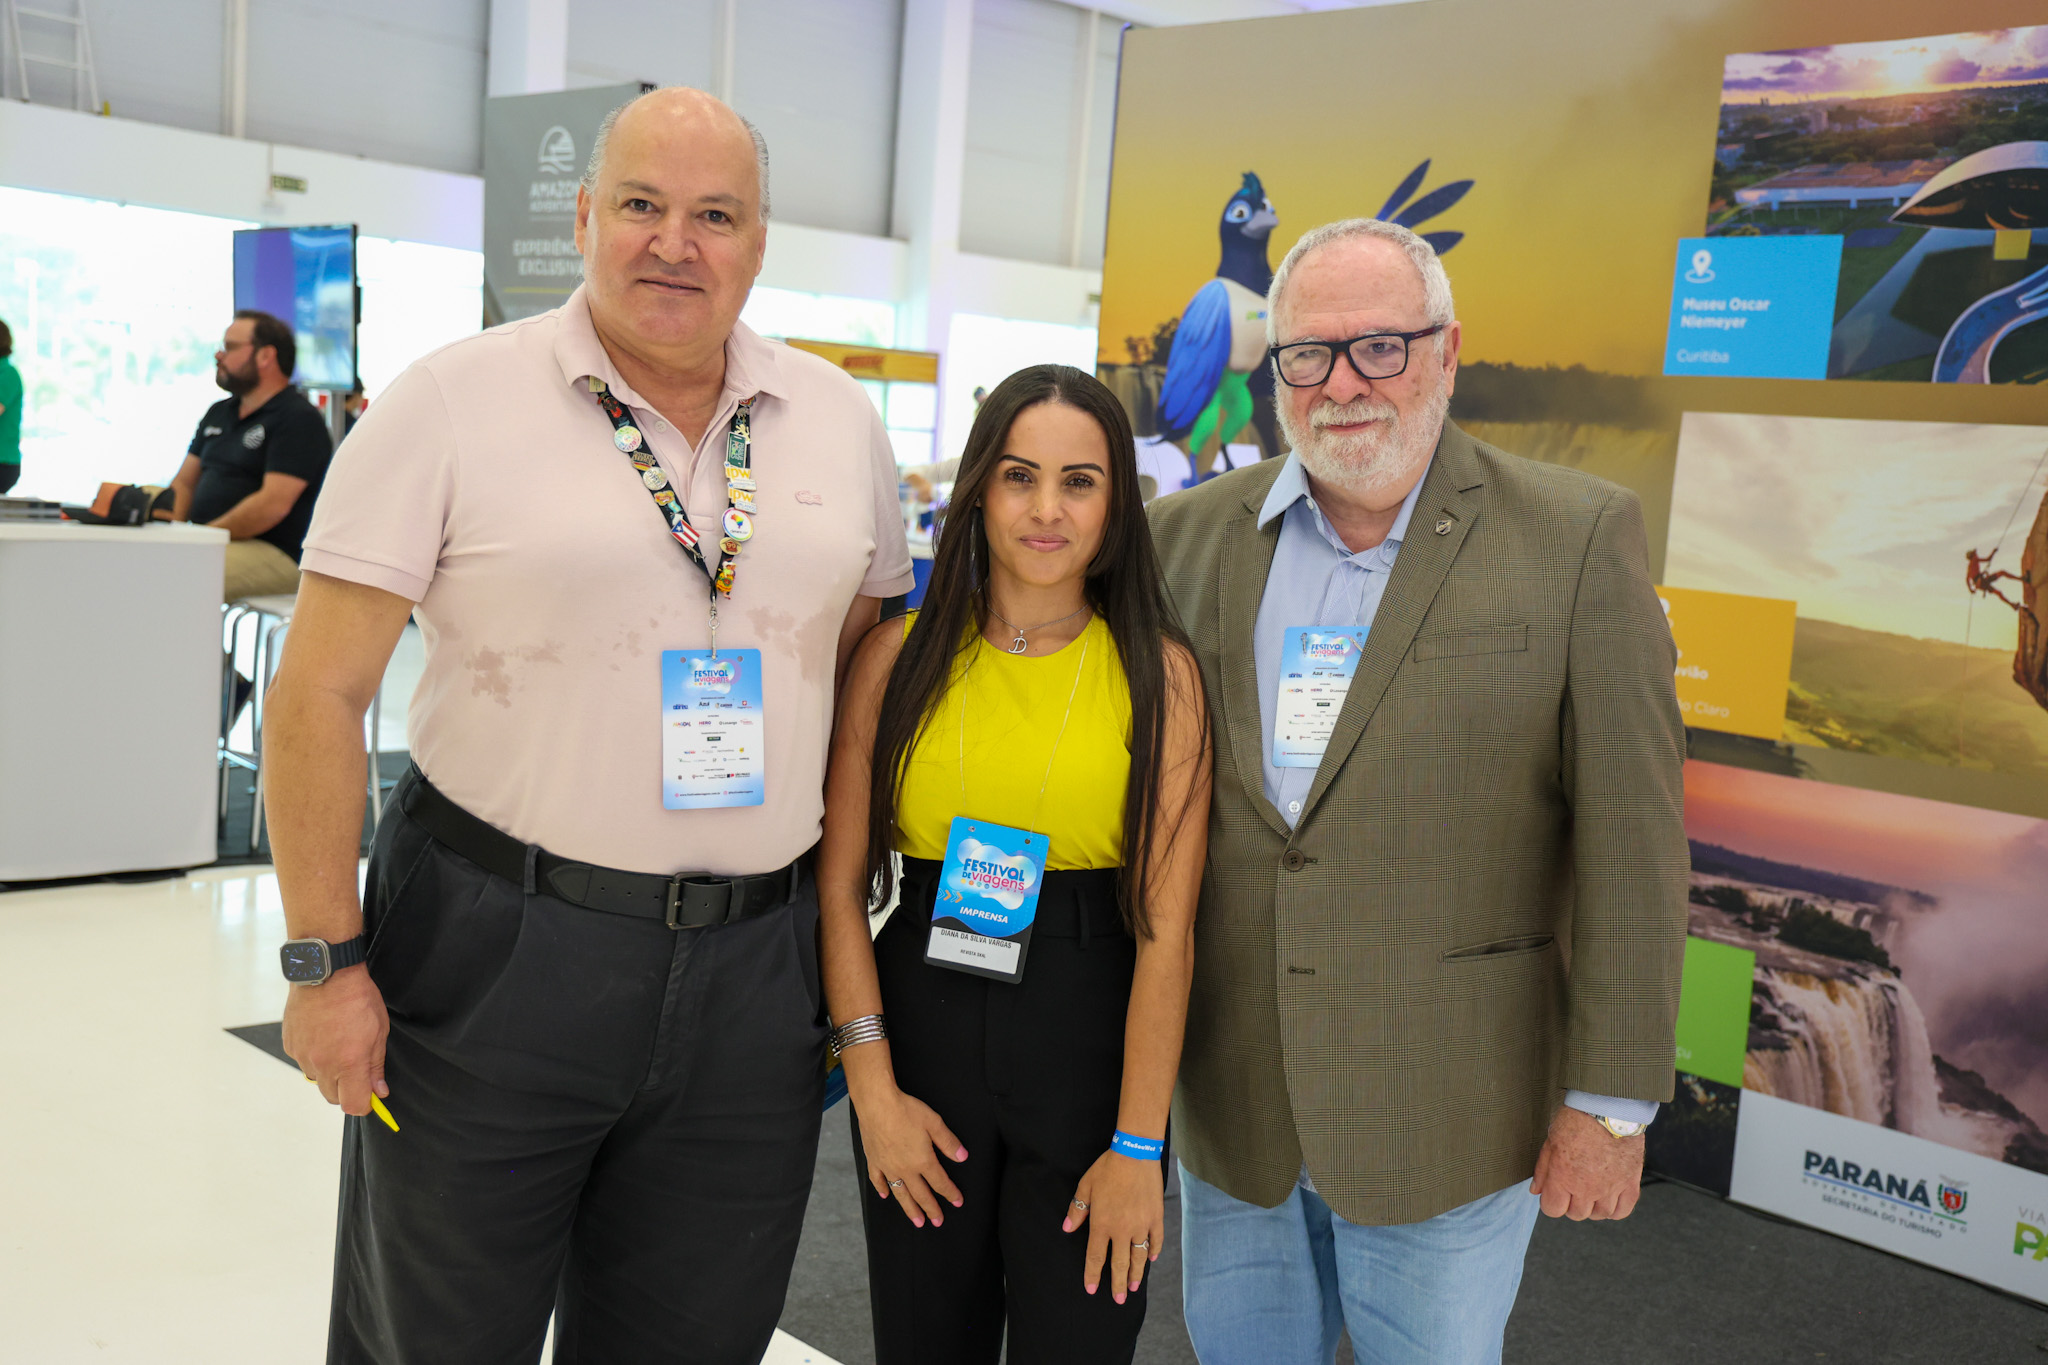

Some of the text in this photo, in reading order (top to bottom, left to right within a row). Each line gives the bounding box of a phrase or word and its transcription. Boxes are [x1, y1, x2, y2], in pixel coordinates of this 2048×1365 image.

[1682, 297, 1771, 311] Museu Oscar
[1680, 315, 1747, 330] Niemeyer
[1676, 349, 1730, 363] Curitiba
[700, 676, 730, 684] viagens
[1694, 701, 1730, 718] Claro
[963, 858, 1025, 882] FESTIVAL
[962, 871, 1025, 891] DE viagens
[960, 906, 1008, 924] IMPRENSA
[941, 929, 1012, 949] DIANA DA SILVA VARGAS
[960, 949, 976, 957] REVISTA
[1804, 1149, 1931, 1208] PARANÁ
[1802, 1178, 1968, 1234] GOVERNO DO ESTADO
[1822, 1193, 1942, 1239] SECRETARIA DO TURISMO
